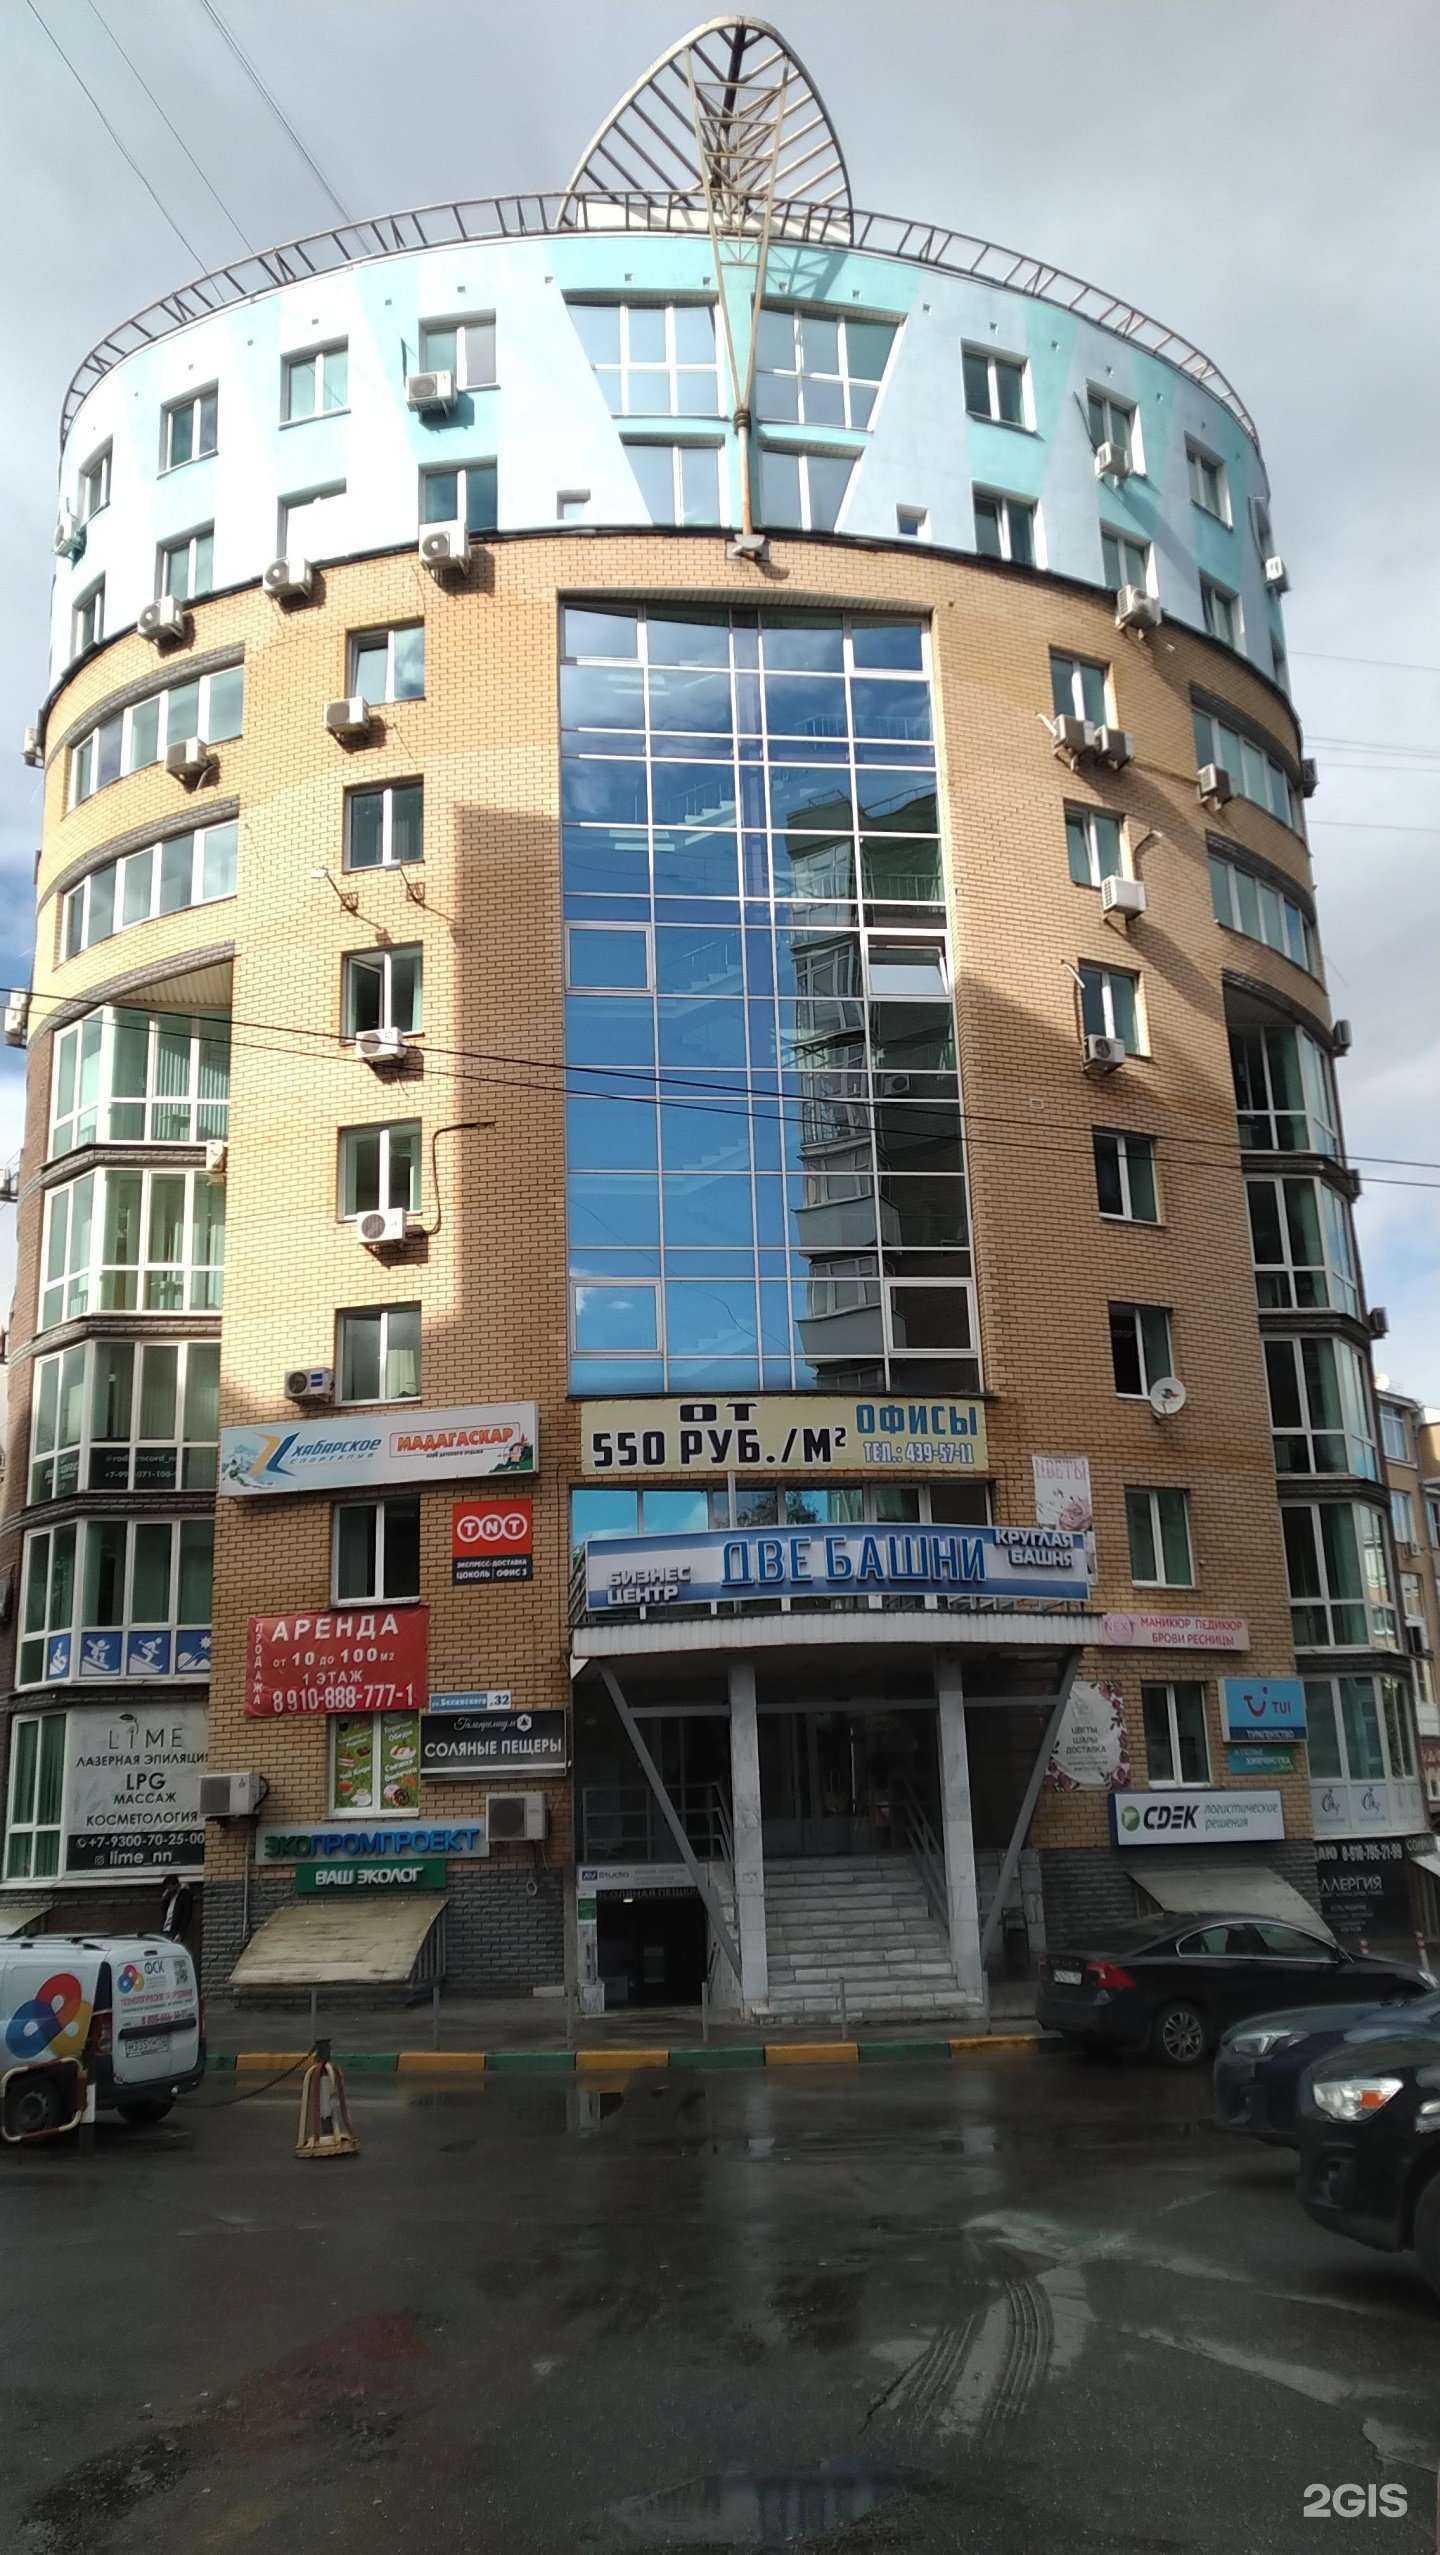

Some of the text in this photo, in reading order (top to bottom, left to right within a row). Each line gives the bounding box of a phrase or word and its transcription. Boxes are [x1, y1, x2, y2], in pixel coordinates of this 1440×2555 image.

[679, 1402, 757, 1423] ОТ
[856, 1404, 978, 1436] ОФИСЫ
[397, 1427, 514, 1451] МАДАГАСКАР
[593, 1431, 664, 1467] 550
[904, 1442, 975, 1464] 439-57-11
[457, 1513, 528, 1543] TNT
[995, 1529, 1073, 1548] КРУГЛАЯ
[720, 1535, 987, 1587] ДВЕ БАШНИ
[1009, 1549, 1073, 1567] БАШНЯ
[457, 1571, 490, 1579] ЦОКОЛЬ
[496, 1569, 520, 1577] ОФИС
[607, 1567, 691, 1586] БИЗНЕС
[607, 1586, 680, 1605] ЦЕНТР
[271, 1613, 399, 1642] АРЕНДА
[1141, 1617, 1243, 1630] МАНИКЮР ПЕДИКЮР
[1152, 1633, 1234, 1646] БРОВИ РЕСНИЦЫ
[252, 1623, 264, 1705] ПРОДАЖА
[291, 1652, 315, 1666] 10
[340, 1648, 378, 1663] 100
[302, 1670, 363, 1685] 1 ЭТАЖ
[1272, 1701, 1293, 1714] TUI
[424, 1739, 562, 1758] СОЛЯНЫЕ ПЕЩЕРЫ
[1066, 1746, 1107, 1754] ДОСТАВКА
[76, 1755, 140, 1767] ЛАЗЕРНАЯ
[126, 1772, 166, 1790] LPG
[113, 1792, 177, 1804] МАССАЖ
[86, 1811, 198, 1826] КОСМЕТОЛОГИЯ
[1143, 1805, 1200, 1830] CDEK
[88, 1832, 205, 1848] +7-9300-70-25-00
[264, 1828, 479, 1858] ЭКОПРОМПРОЕКТ
[315, 1867, 423, 1885] ВАШ ЭКОЛОГ
